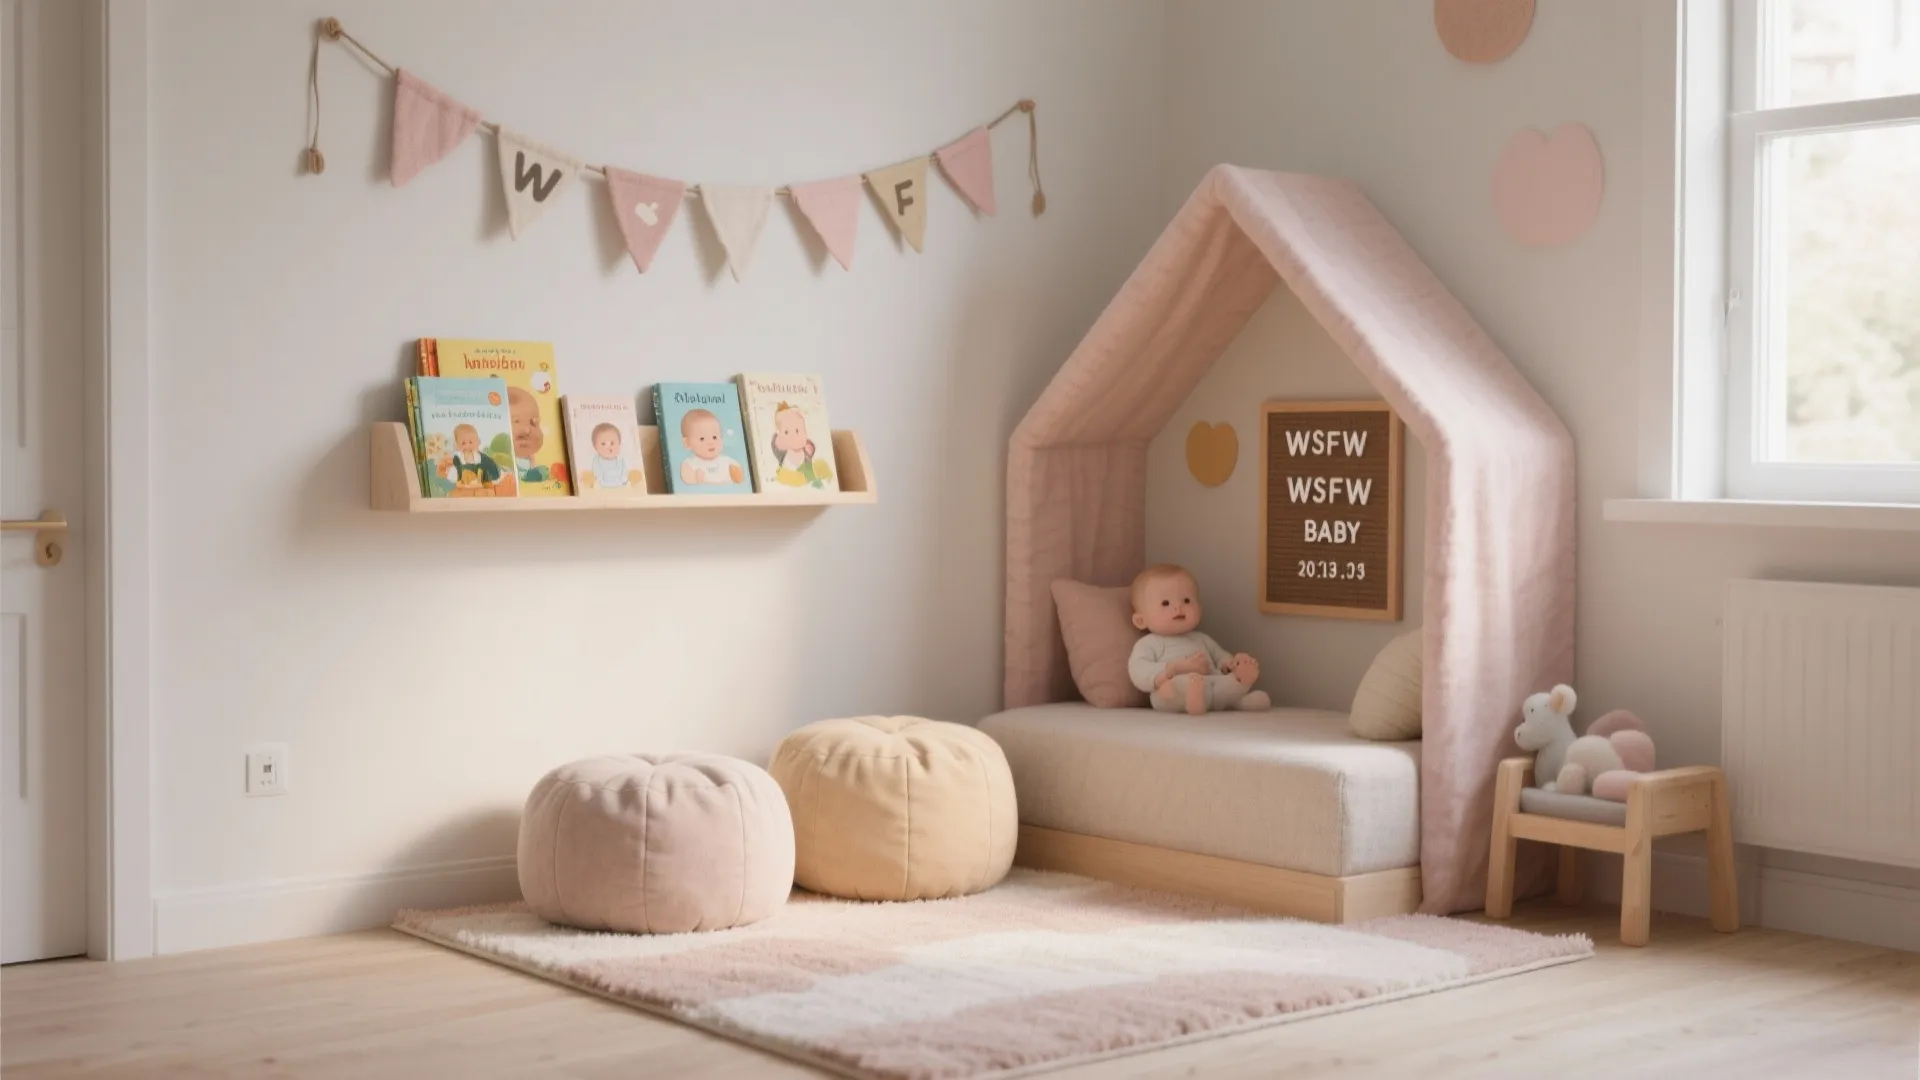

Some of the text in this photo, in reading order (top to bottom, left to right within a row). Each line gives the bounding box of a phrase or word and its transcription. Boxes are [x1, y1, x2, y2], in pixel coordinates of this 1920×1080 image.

[515, 150, 562, 203] W
[894, 179, 914, 216] F
[1285, 429, 1368, 457] WSFW
[1287, 476, 1372, 505] WSFW
[1304, 519, 1361, 544] BABY
